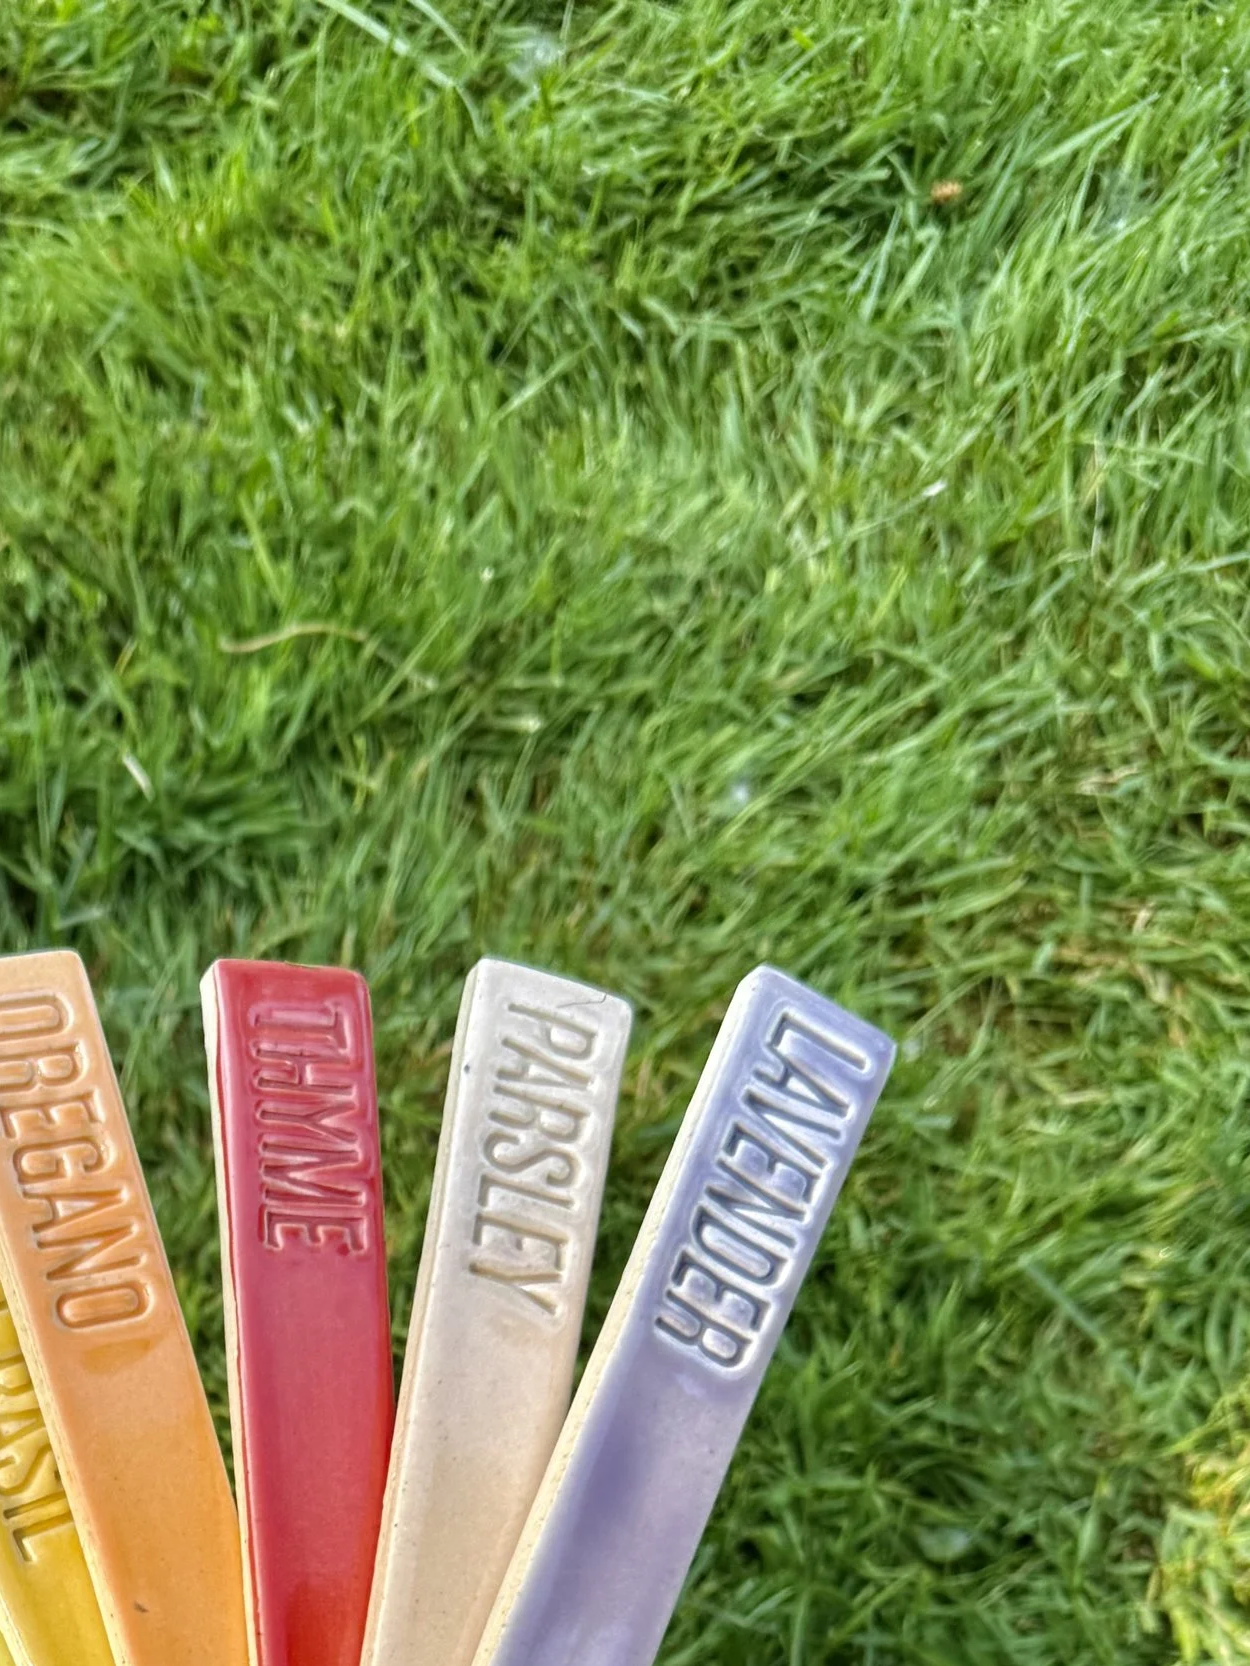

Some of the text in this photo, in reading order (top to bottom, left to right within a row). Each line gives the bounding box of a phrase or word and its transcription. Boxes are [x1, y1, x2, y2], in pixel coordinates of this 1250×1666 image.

[253, 1001, 368, 1255] THYME
[469, 1001, 598, 1320] PARSLEY
[655, 1007, 874, 1370] LAVENDER
